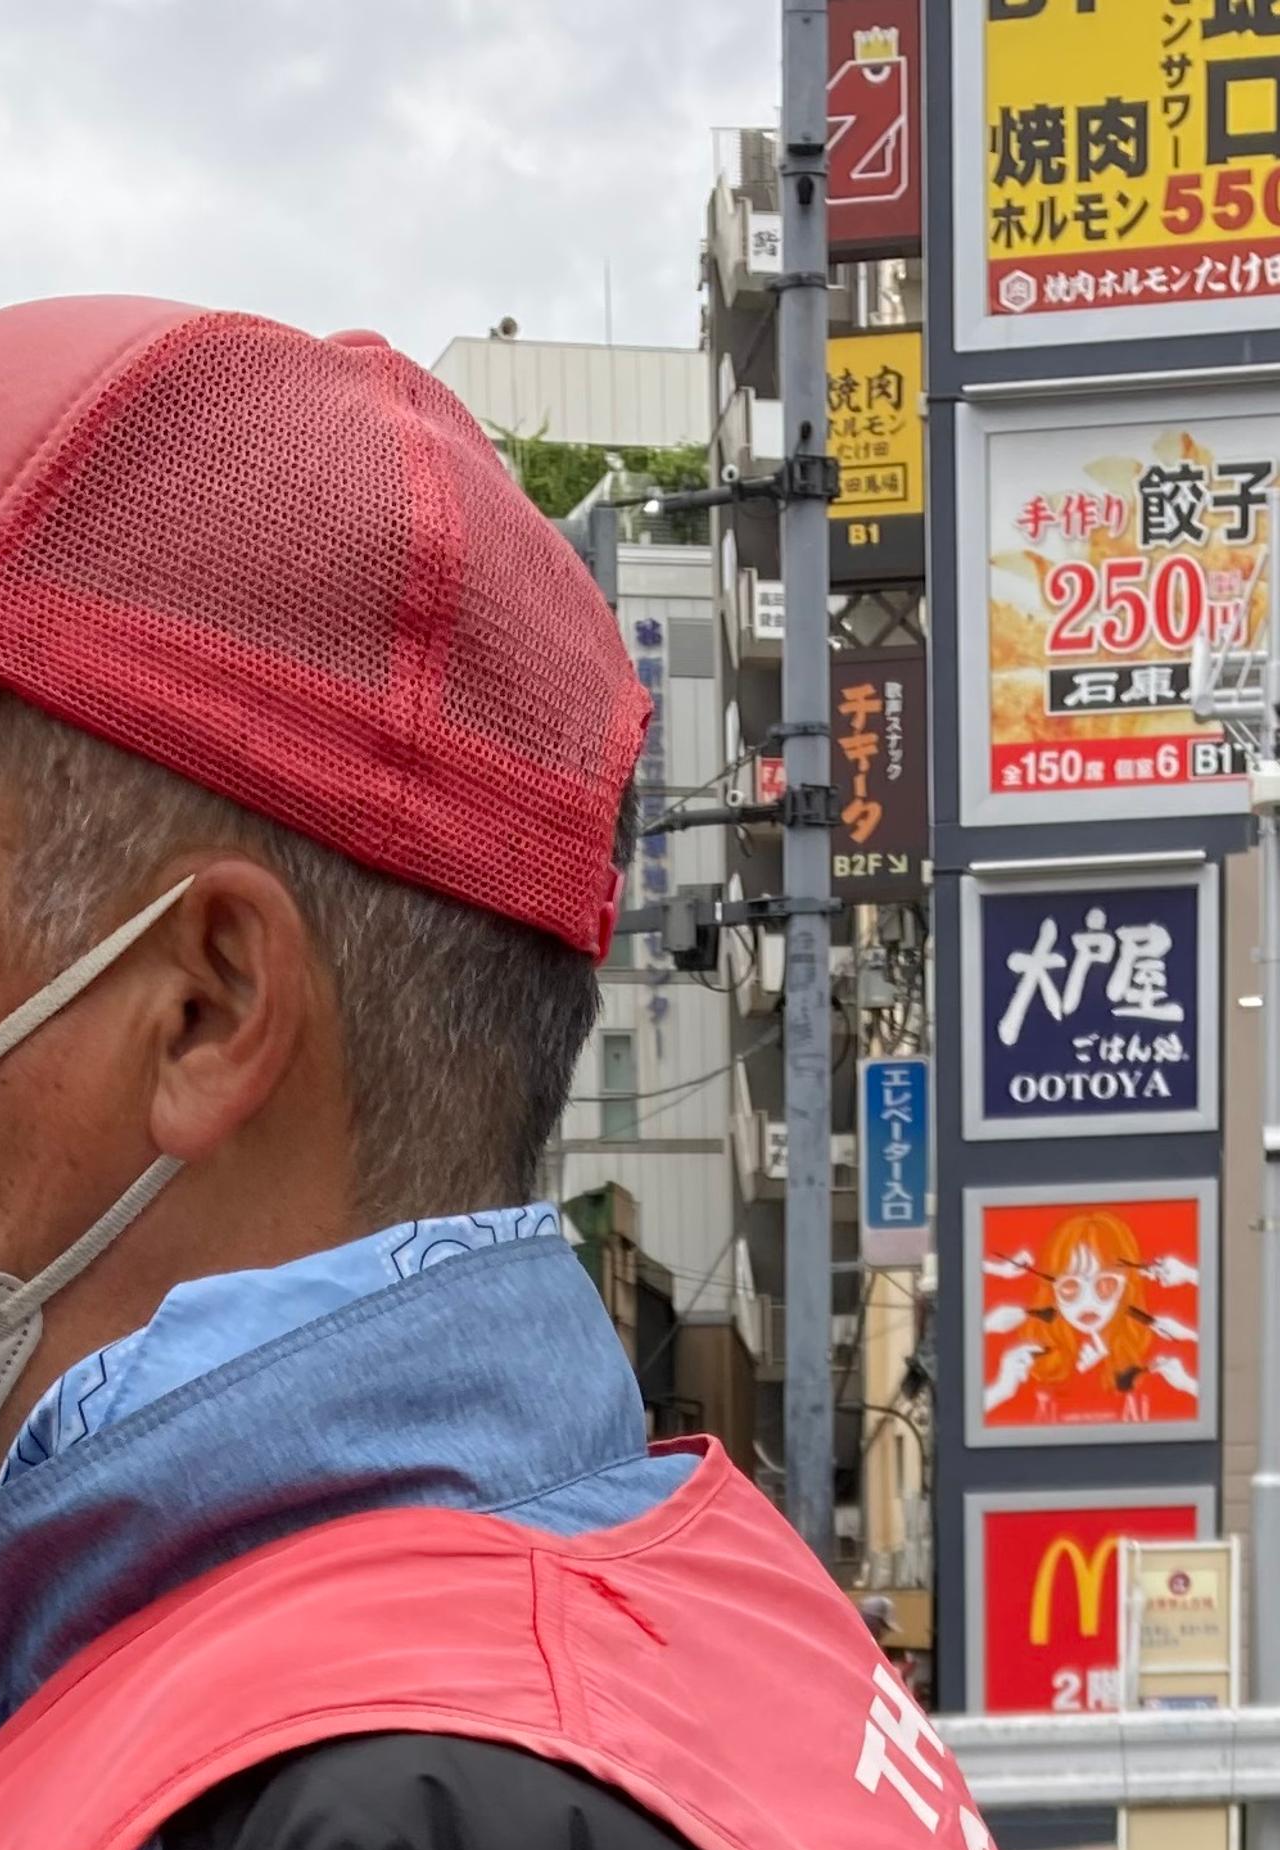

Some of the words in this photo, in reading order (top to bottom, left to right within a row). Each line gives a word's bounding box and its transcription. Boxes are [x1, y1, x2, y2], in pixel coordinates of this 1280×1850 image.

[989, 96, 1149, 189] 焼肉
[990, 190, 1149, 249] ホルモン
[839, 472, 900, 495] 田馬場
[1138, 460, 1274, 547] 餃子
[847, 523, 880, 546] B1
[1017, 493, 1126, 541] 手作り
[832, 854, 883, 878] B2F
[998, 907, 1185, 1046] 大戸屋
[1009, 1069, 1171, 1103] OOTOYA
[881, 1069, 913, 1221] エレベーター入口
